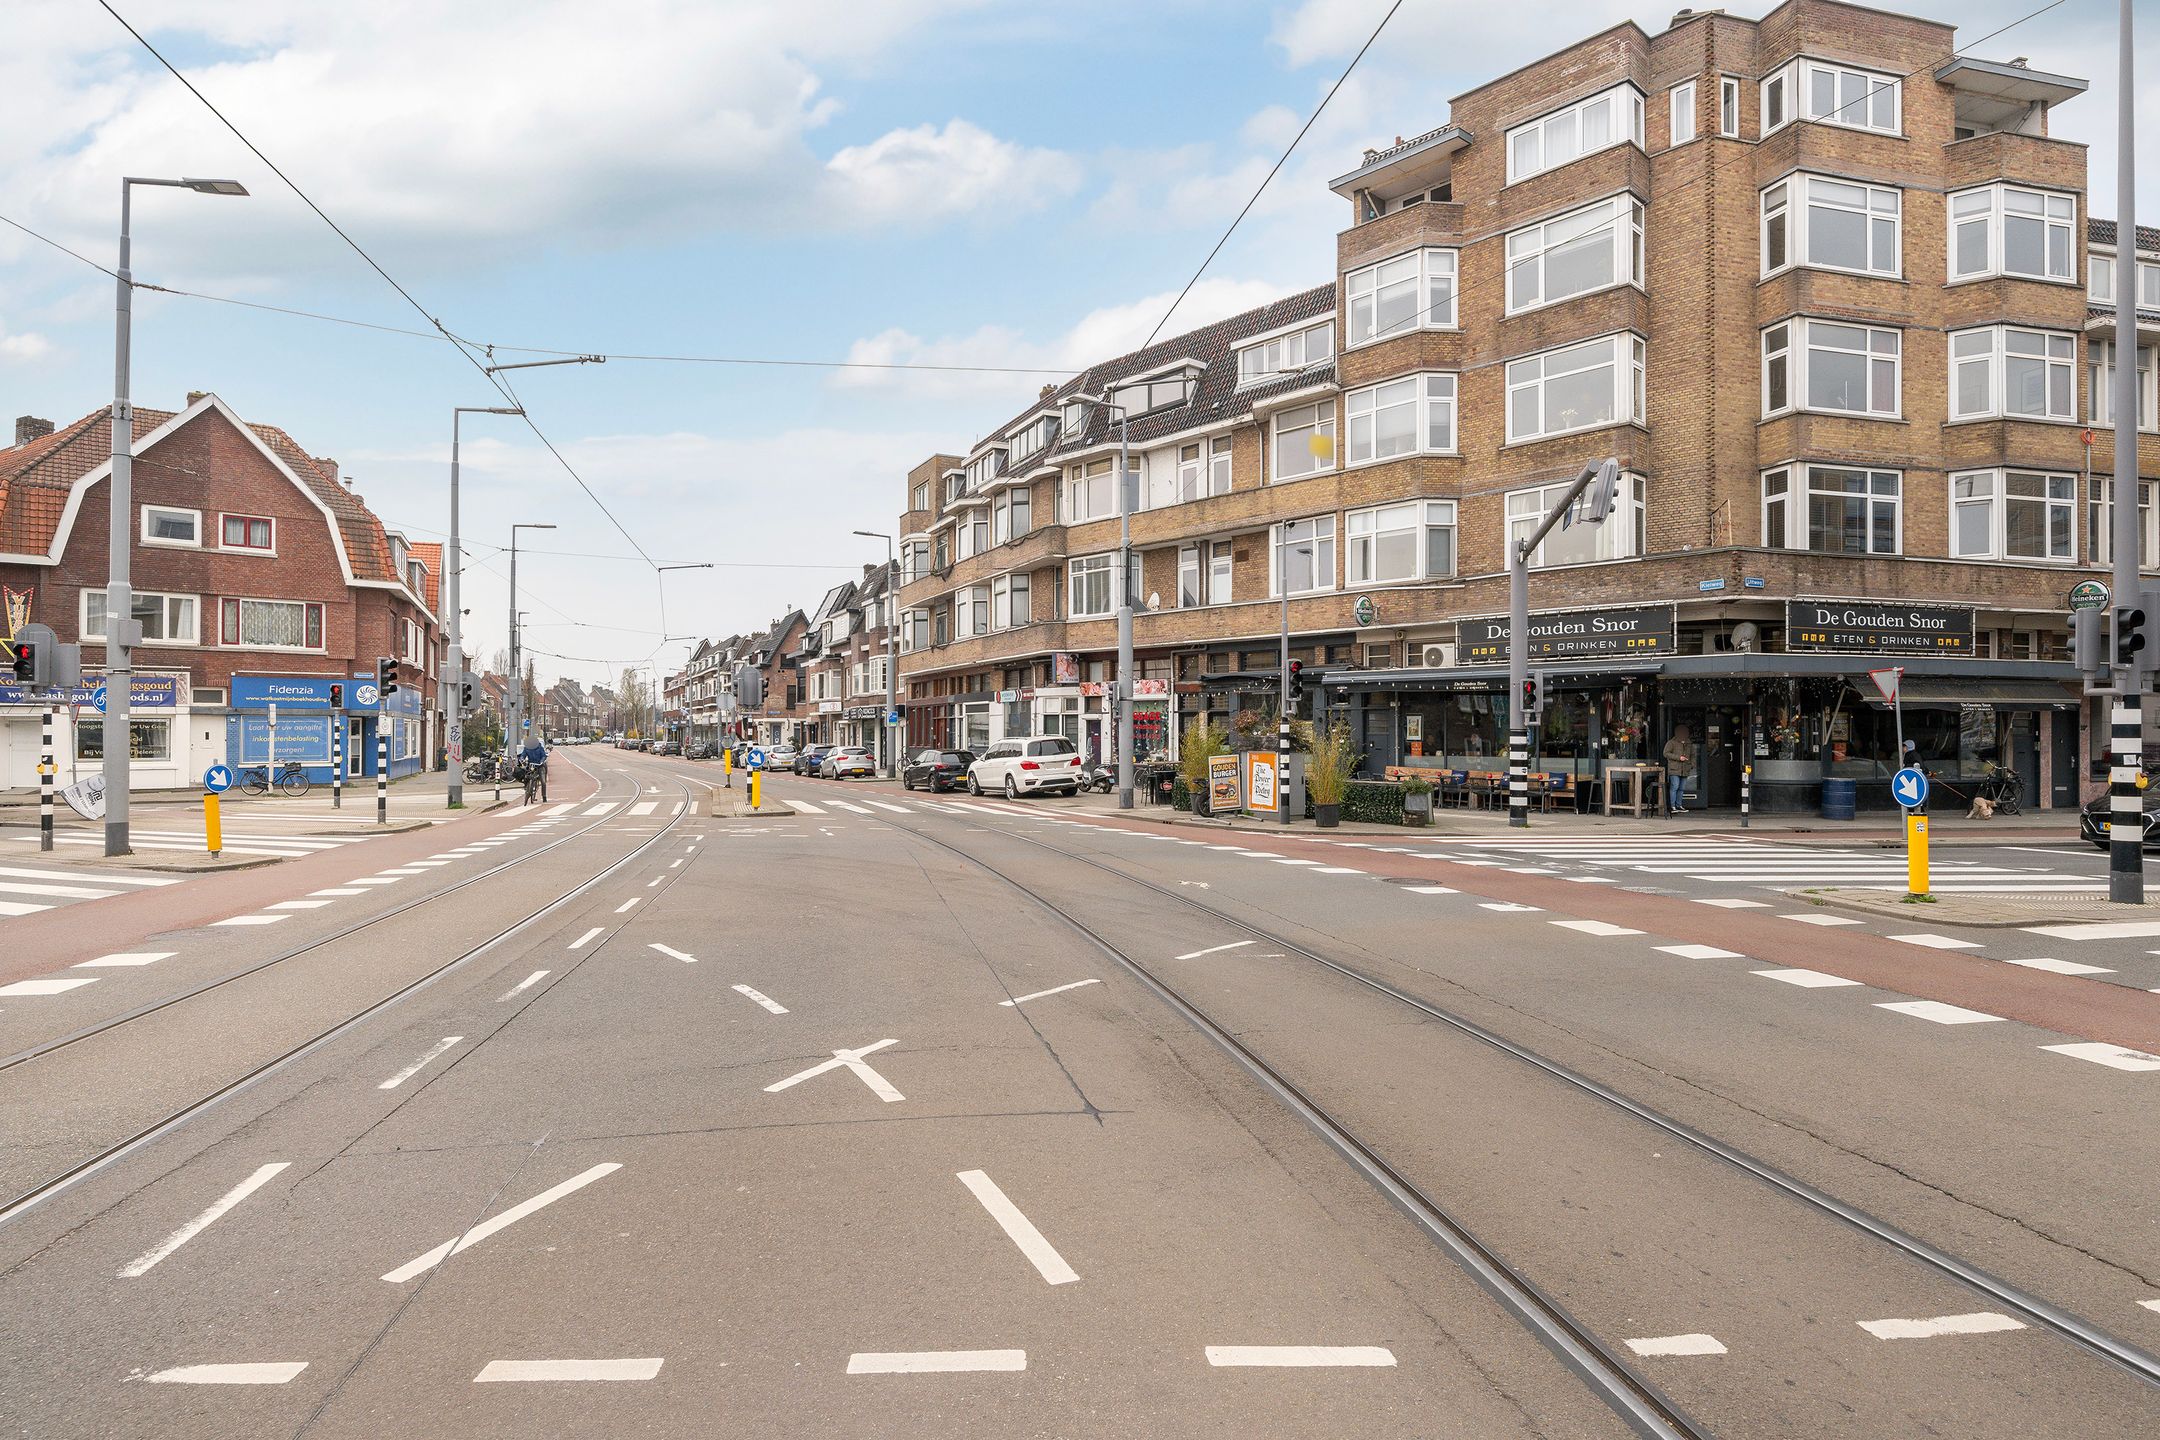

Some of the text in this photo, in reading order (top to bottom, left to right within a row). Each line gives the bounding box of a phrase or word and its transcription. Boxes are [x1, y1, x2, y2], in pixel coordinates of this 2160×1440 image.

[2071, 594, 2106, 602] Heineken
[1816, 609, 1947, 629] De Gouden Snor
[1487, 617, 1639, 640] De ouden Snor
[1833, 634, 1930, 646] ETEN & DRINKEN
[1505, 640, 1617, 654] EN & DRINKEN
[269, 685, 314, 695] Fidenzia
[1212, 763, 1236, 772] GOUDEN
[1213, 769, 1237, 778] BURGER
